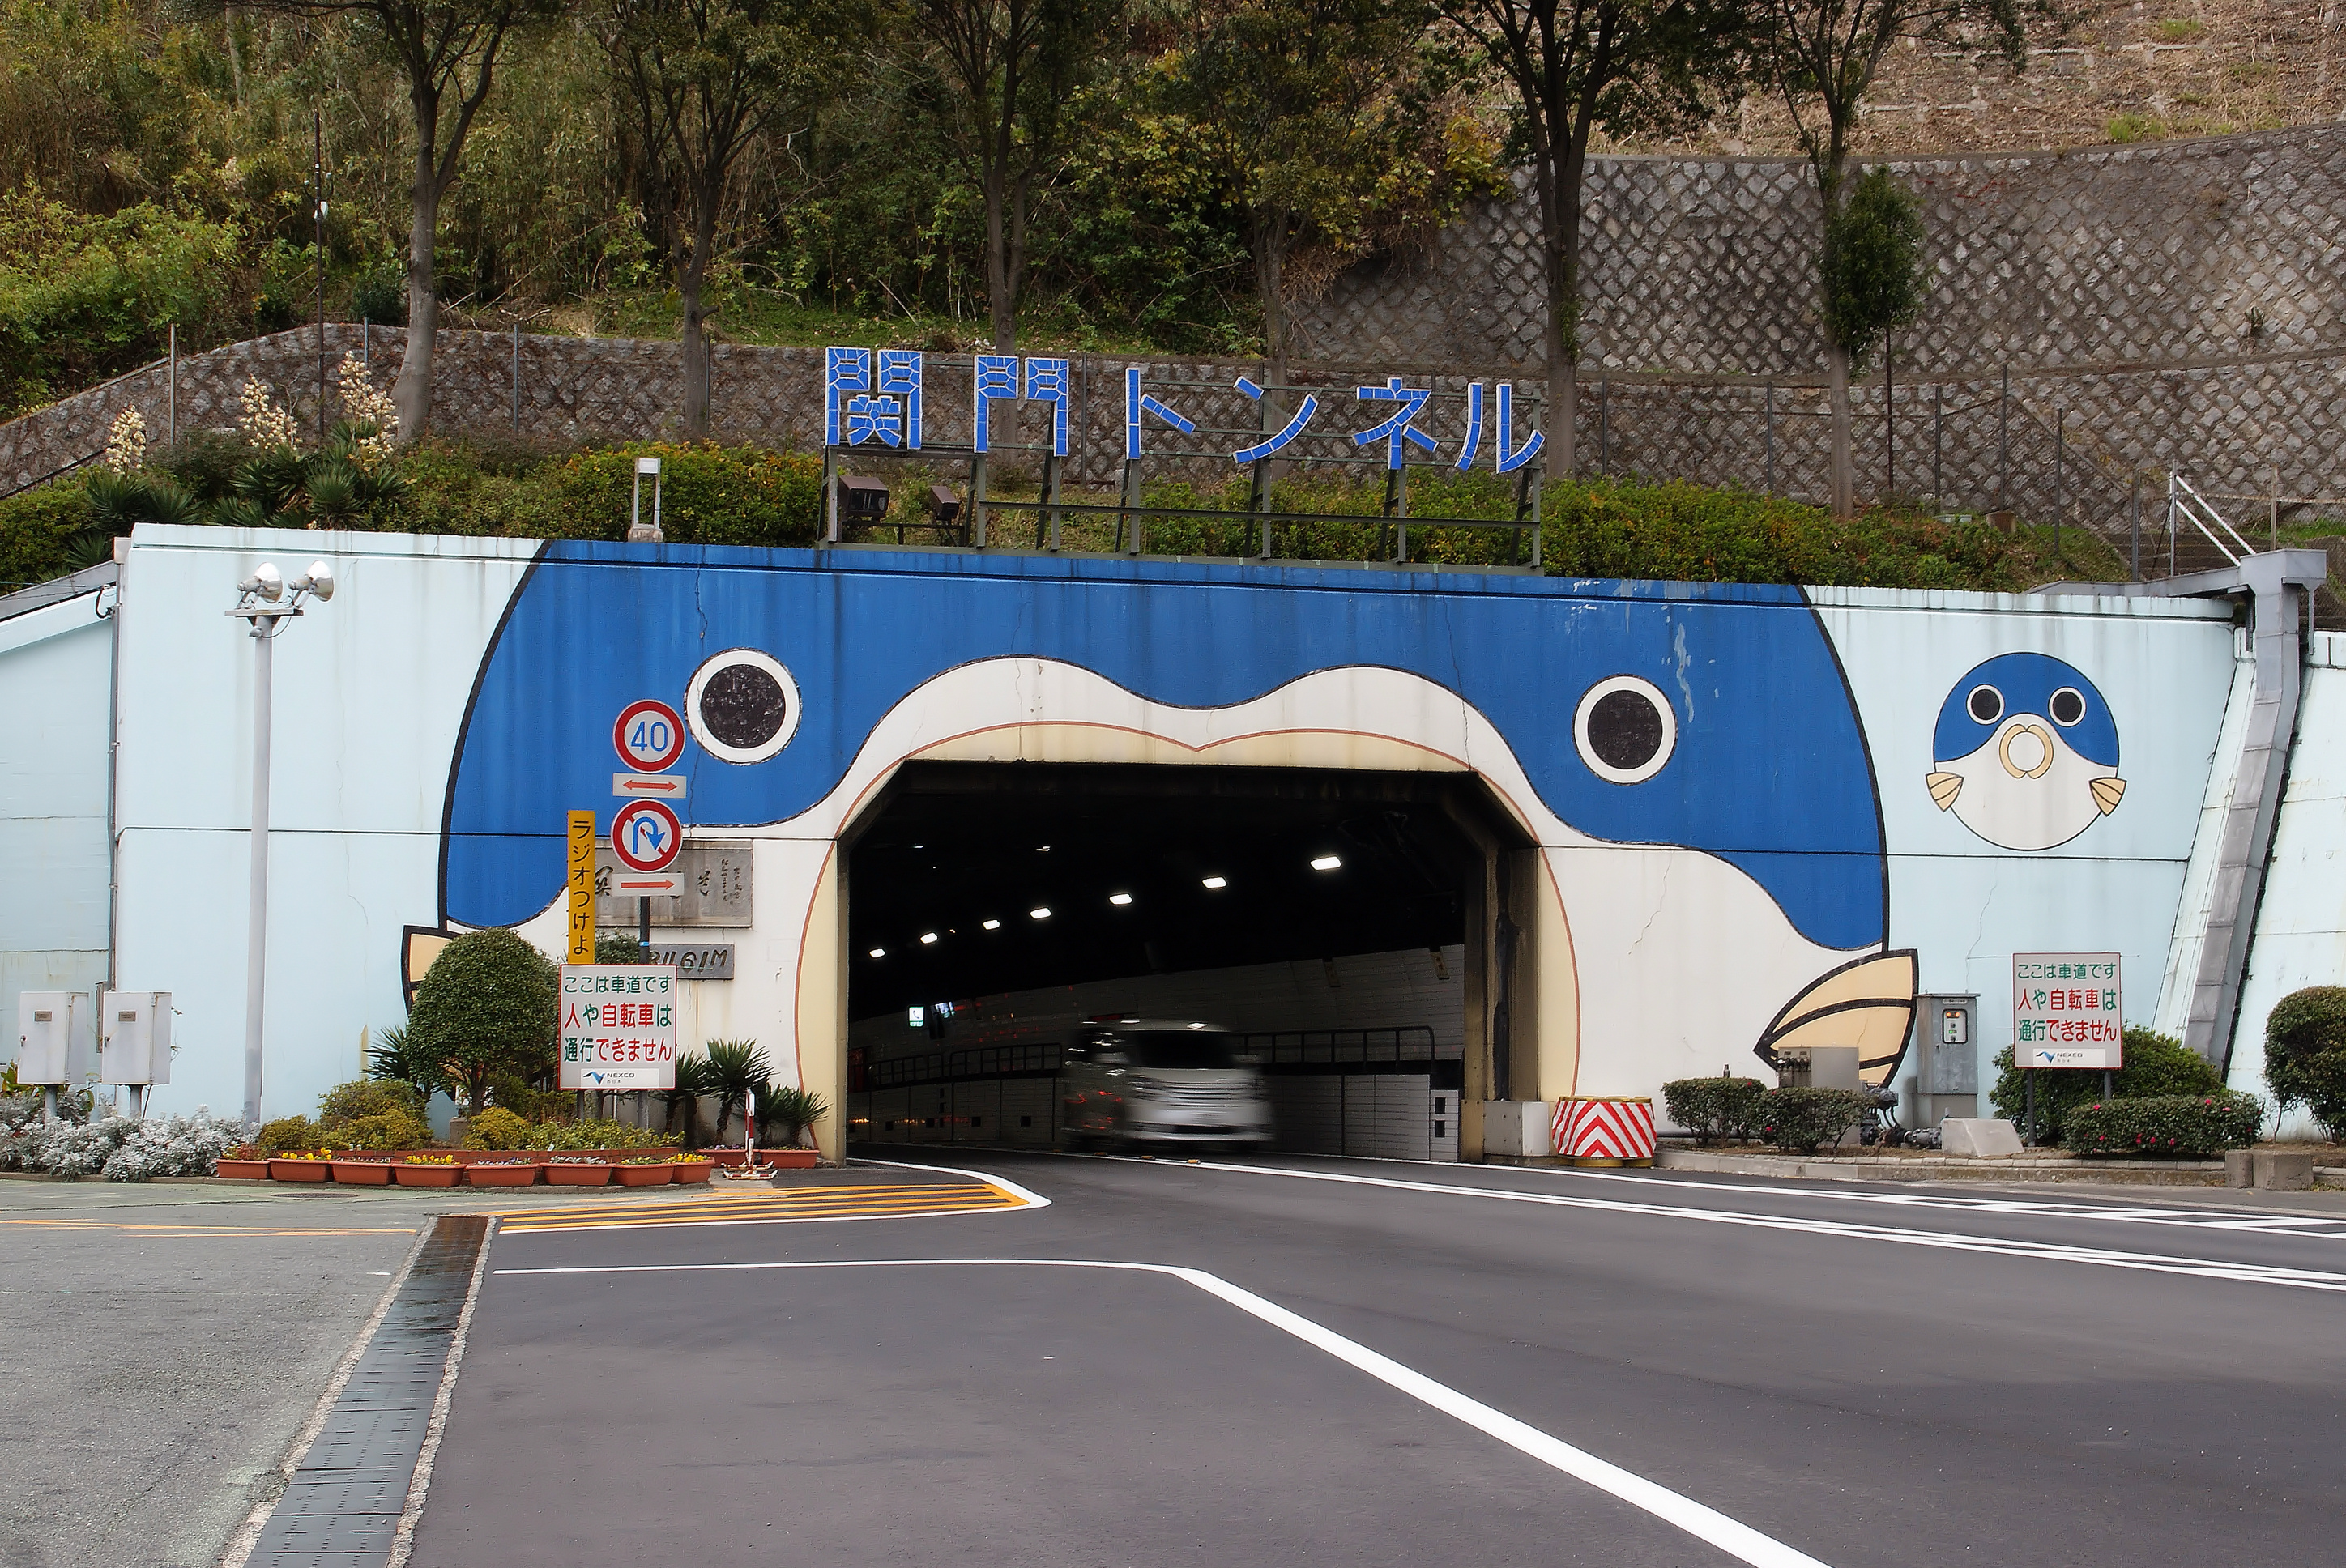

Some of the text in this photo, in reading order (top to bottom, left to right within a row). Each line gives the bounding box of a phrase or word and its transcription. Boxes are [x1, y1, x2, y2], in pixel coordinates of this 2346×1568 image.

[825, 346, 1546, 475] 関門トンネル
[630, 721, 668, 752] 40
[572, 820, 591, 955] ラジオつけよ
[2017, 963, 2117, 979] ここは車道です
[564, 975, 672, 994] ここは車道です
[2017, 988, 2117, 1011] 人や自転車は
[564, 1003, 672, 1029] 人や自転車は
[2018, 1020, 2117, 1042] 通行できません
[564, 1037, 672, 1063] 通行できません
